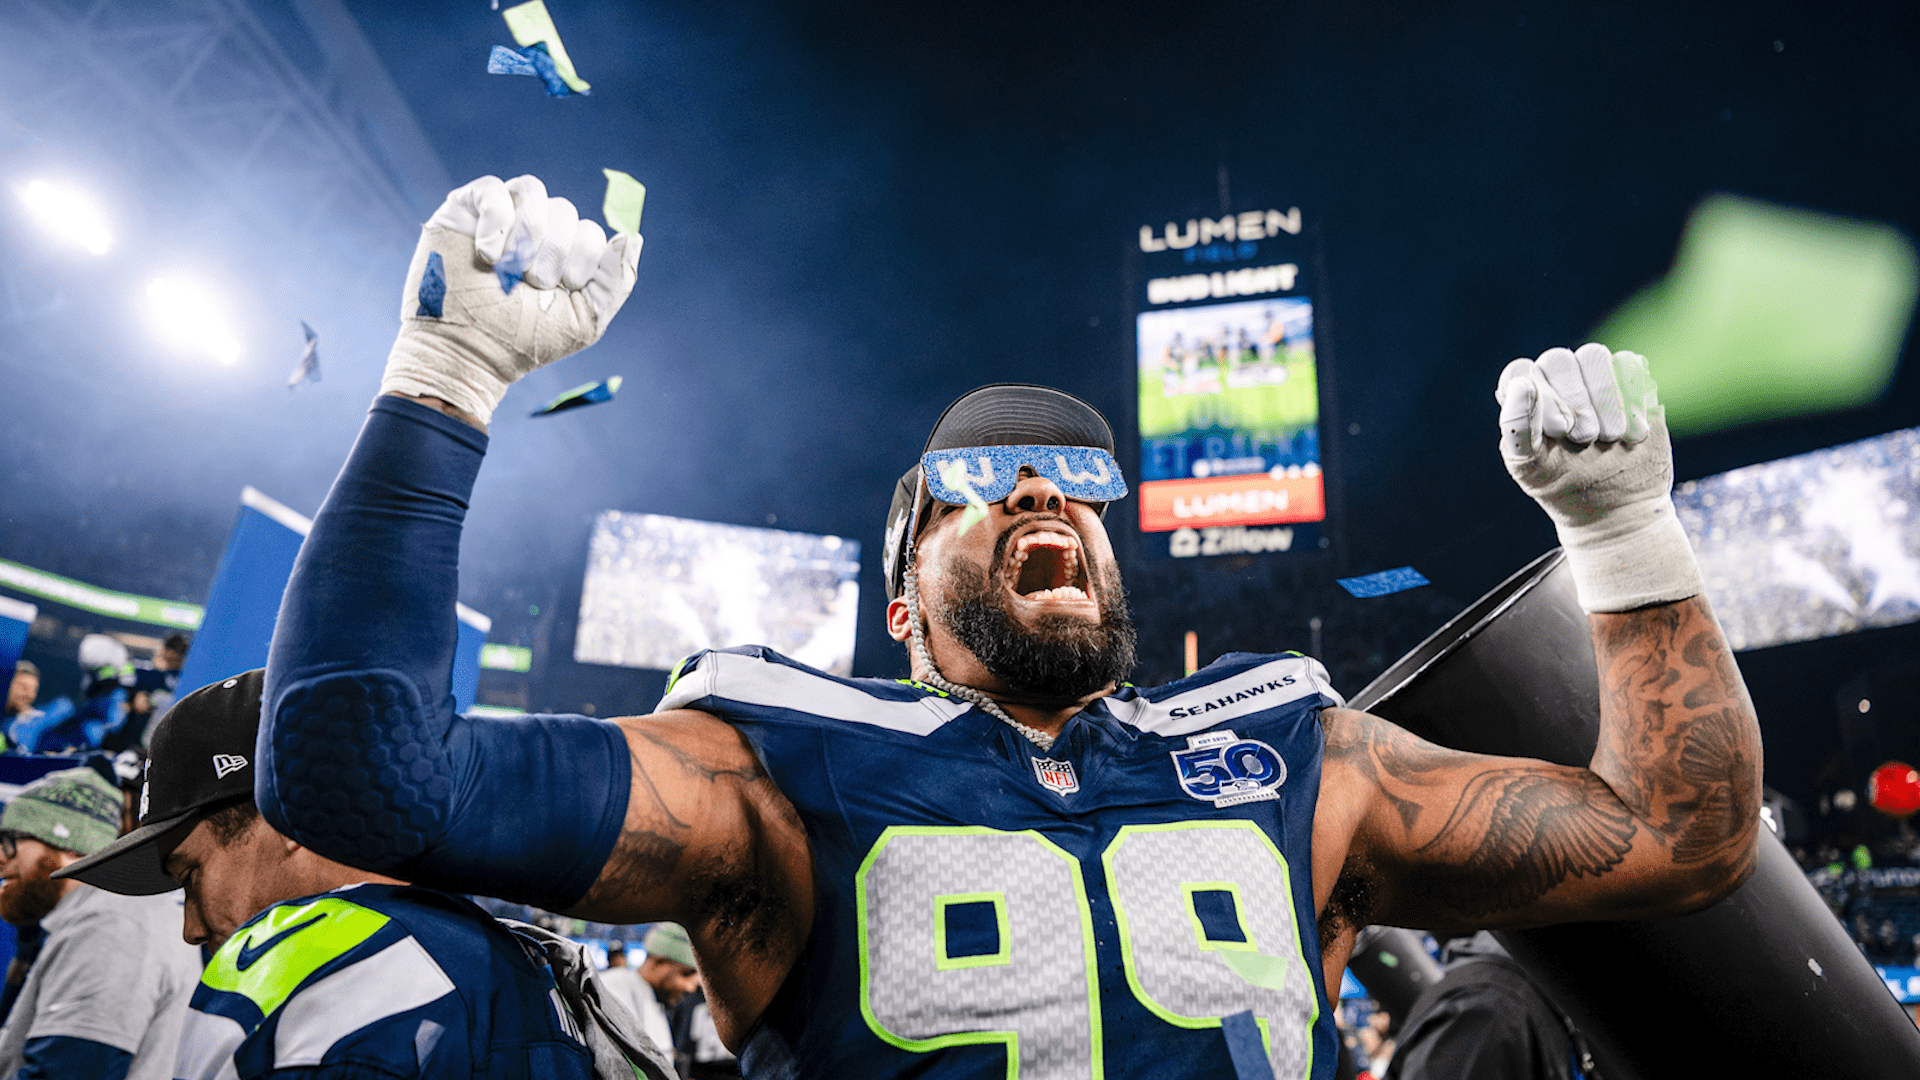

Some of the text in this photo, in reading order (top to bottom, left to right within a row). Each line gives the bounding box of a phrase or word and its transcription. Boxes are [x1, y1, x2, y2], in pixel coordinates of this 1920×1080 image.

[1139, 206, 1301, 252] LUMEN
[1055, 455, 1112, 485] W
[1173, 490, 1289, 518] LUMEN
[1043, 769, 1073, 787] NFL
[1175, 742, 1284, 798] 50
[855, 819, 1319, 1080] 99
